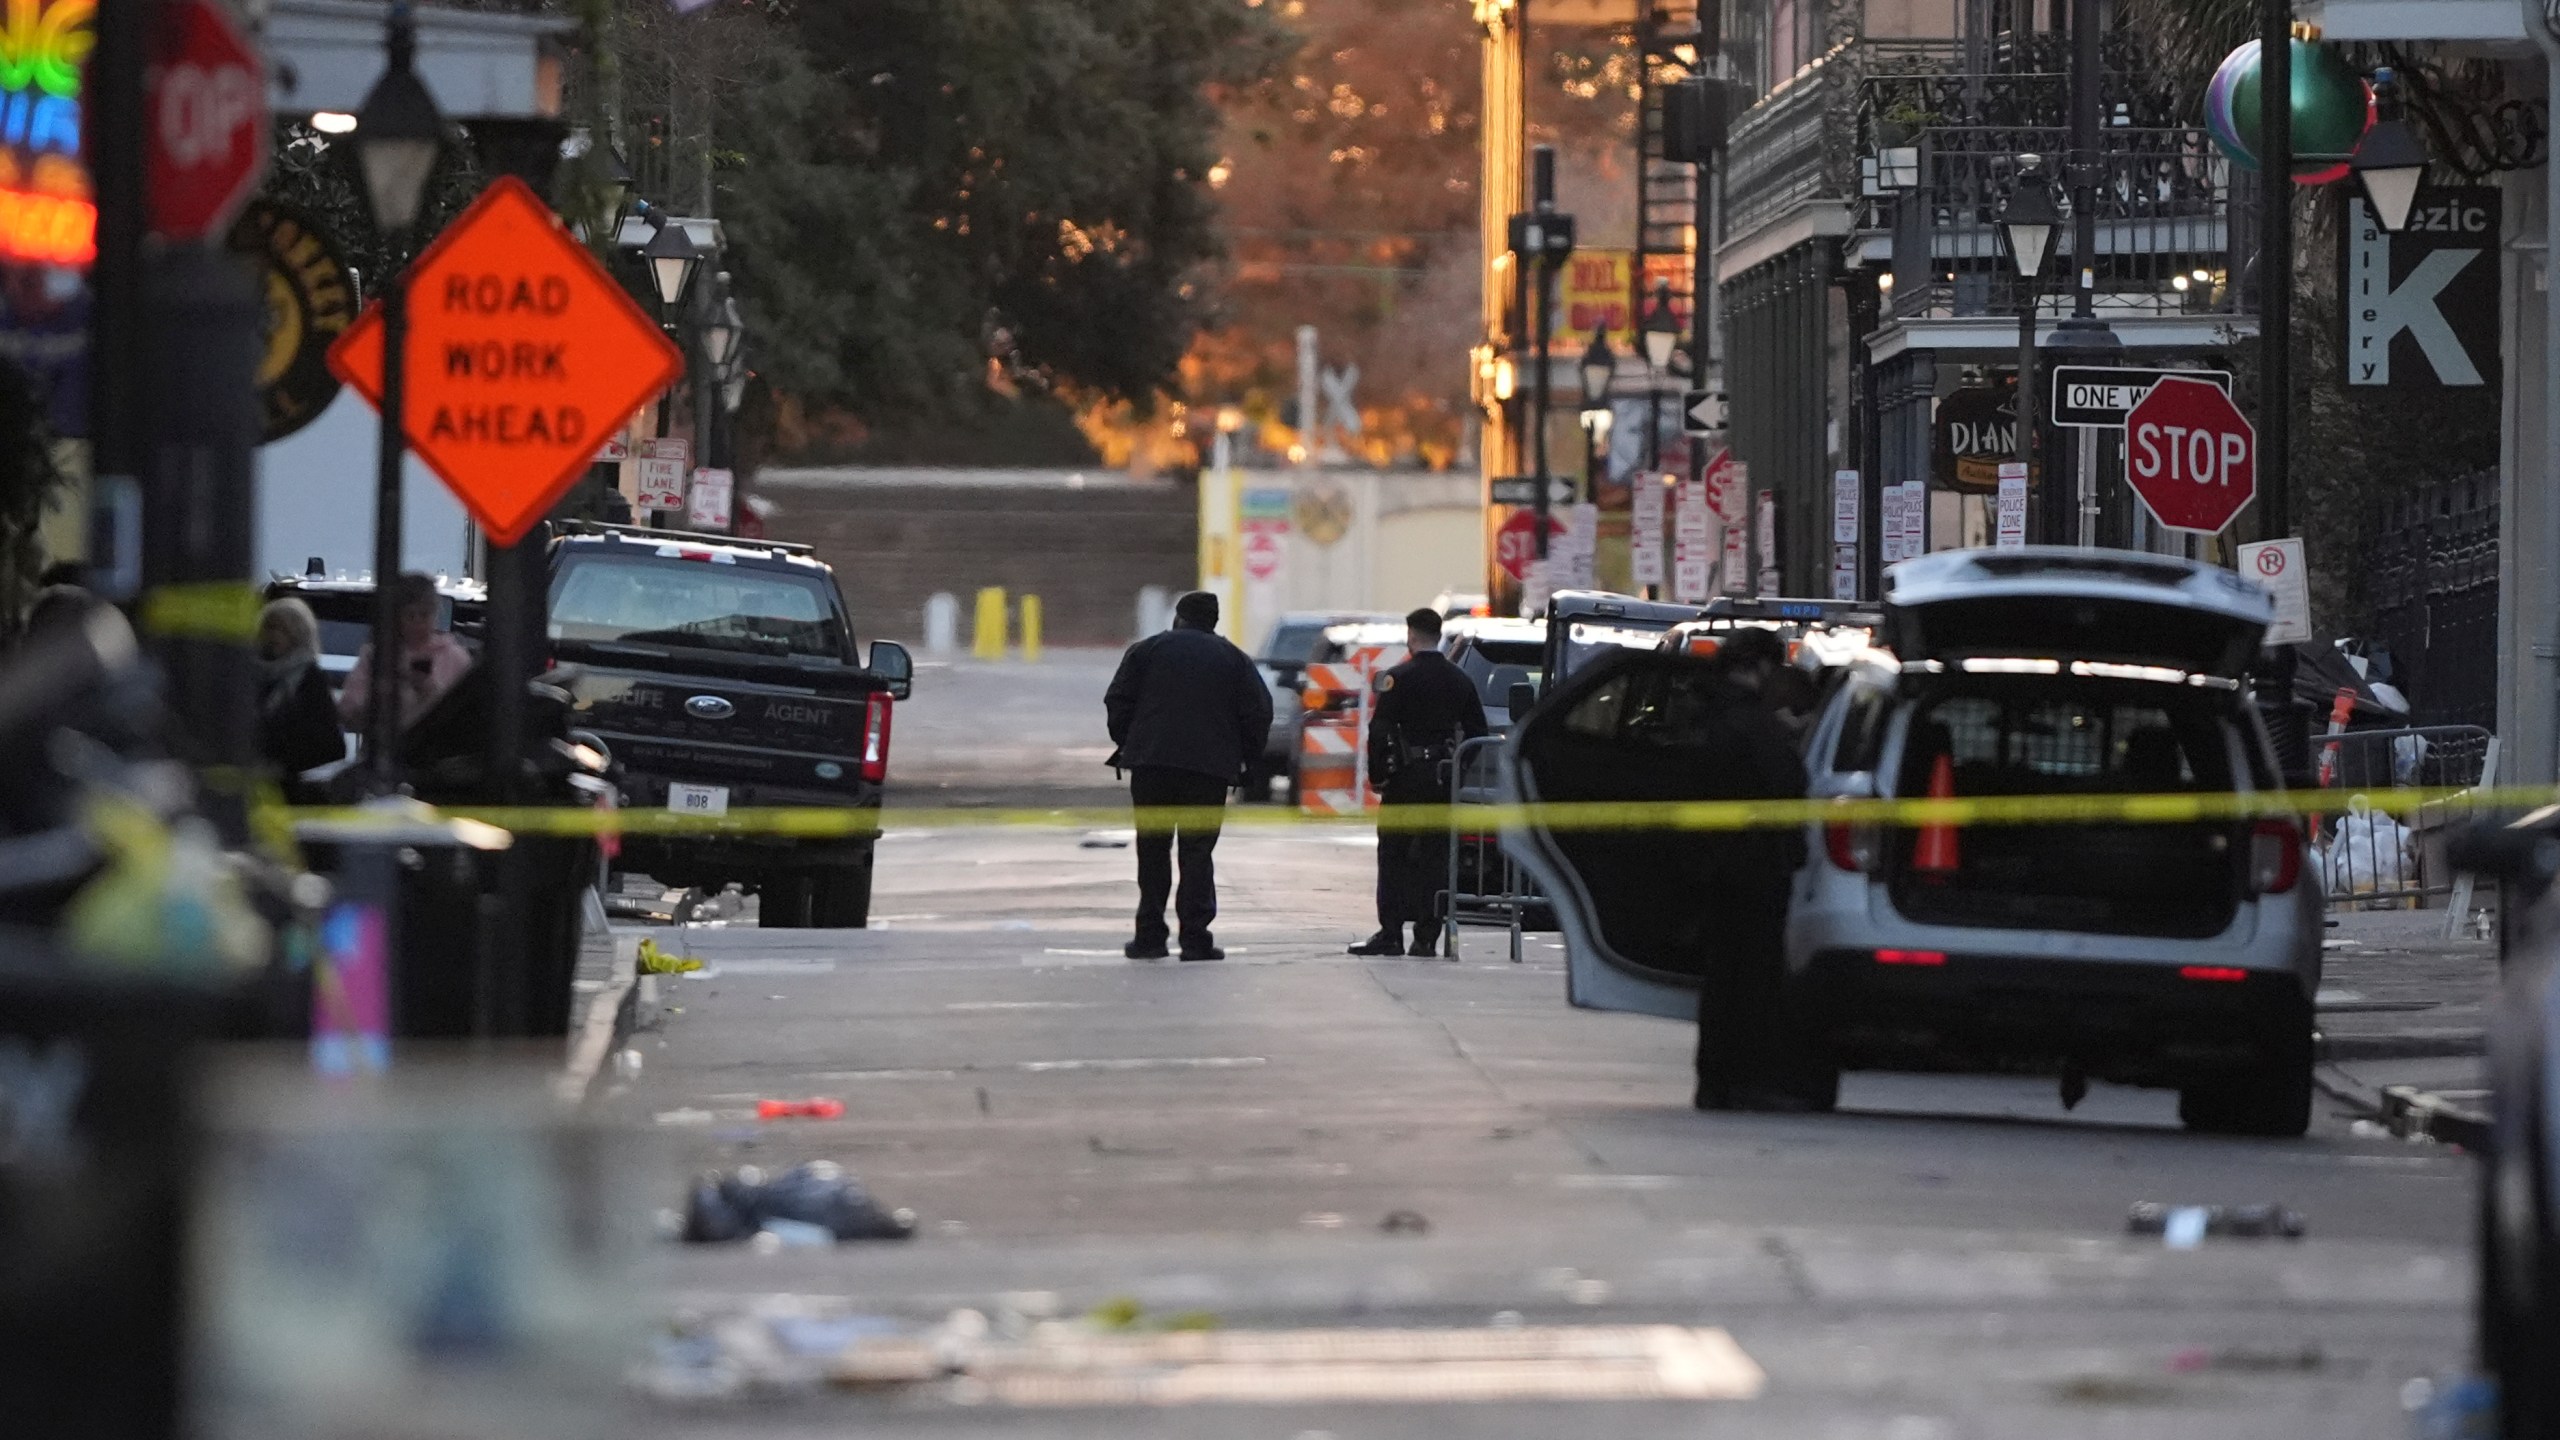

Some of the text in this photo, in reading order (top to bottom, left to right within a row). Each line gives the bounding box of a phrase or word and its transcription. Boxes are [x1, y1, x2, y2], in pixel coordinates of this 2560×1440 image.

[160, 62, 256, 164] OP
[443, 273, 570, 317] ROAD
[2349, 197, 2486, 386] K
[446, 341, 566, 381] WORK
[2073, 386, 2119, 408] ONE
[430, 406, 587, 444] AHEAD
[1951, 421, 2017, 455] DIAN
[2134, 422, 2246, 486] STOP
[650, 463, 673, 475] FIRE
[647, 477, 674, 490] LANE
[1883, 504, 1903, 518] POLIC
[1903, 500, 1923, 513] POLICE
[1999, 498, 2024, 512] POLICE
[1906, 515, 1921, 528] ZONE
[2002, 514, 2021, 528] ZONE
[1500, 531, 1535, 560] ST
[1782, 605, 1820, 616] NOPD
[764, 703, 832, 724] AGENT
